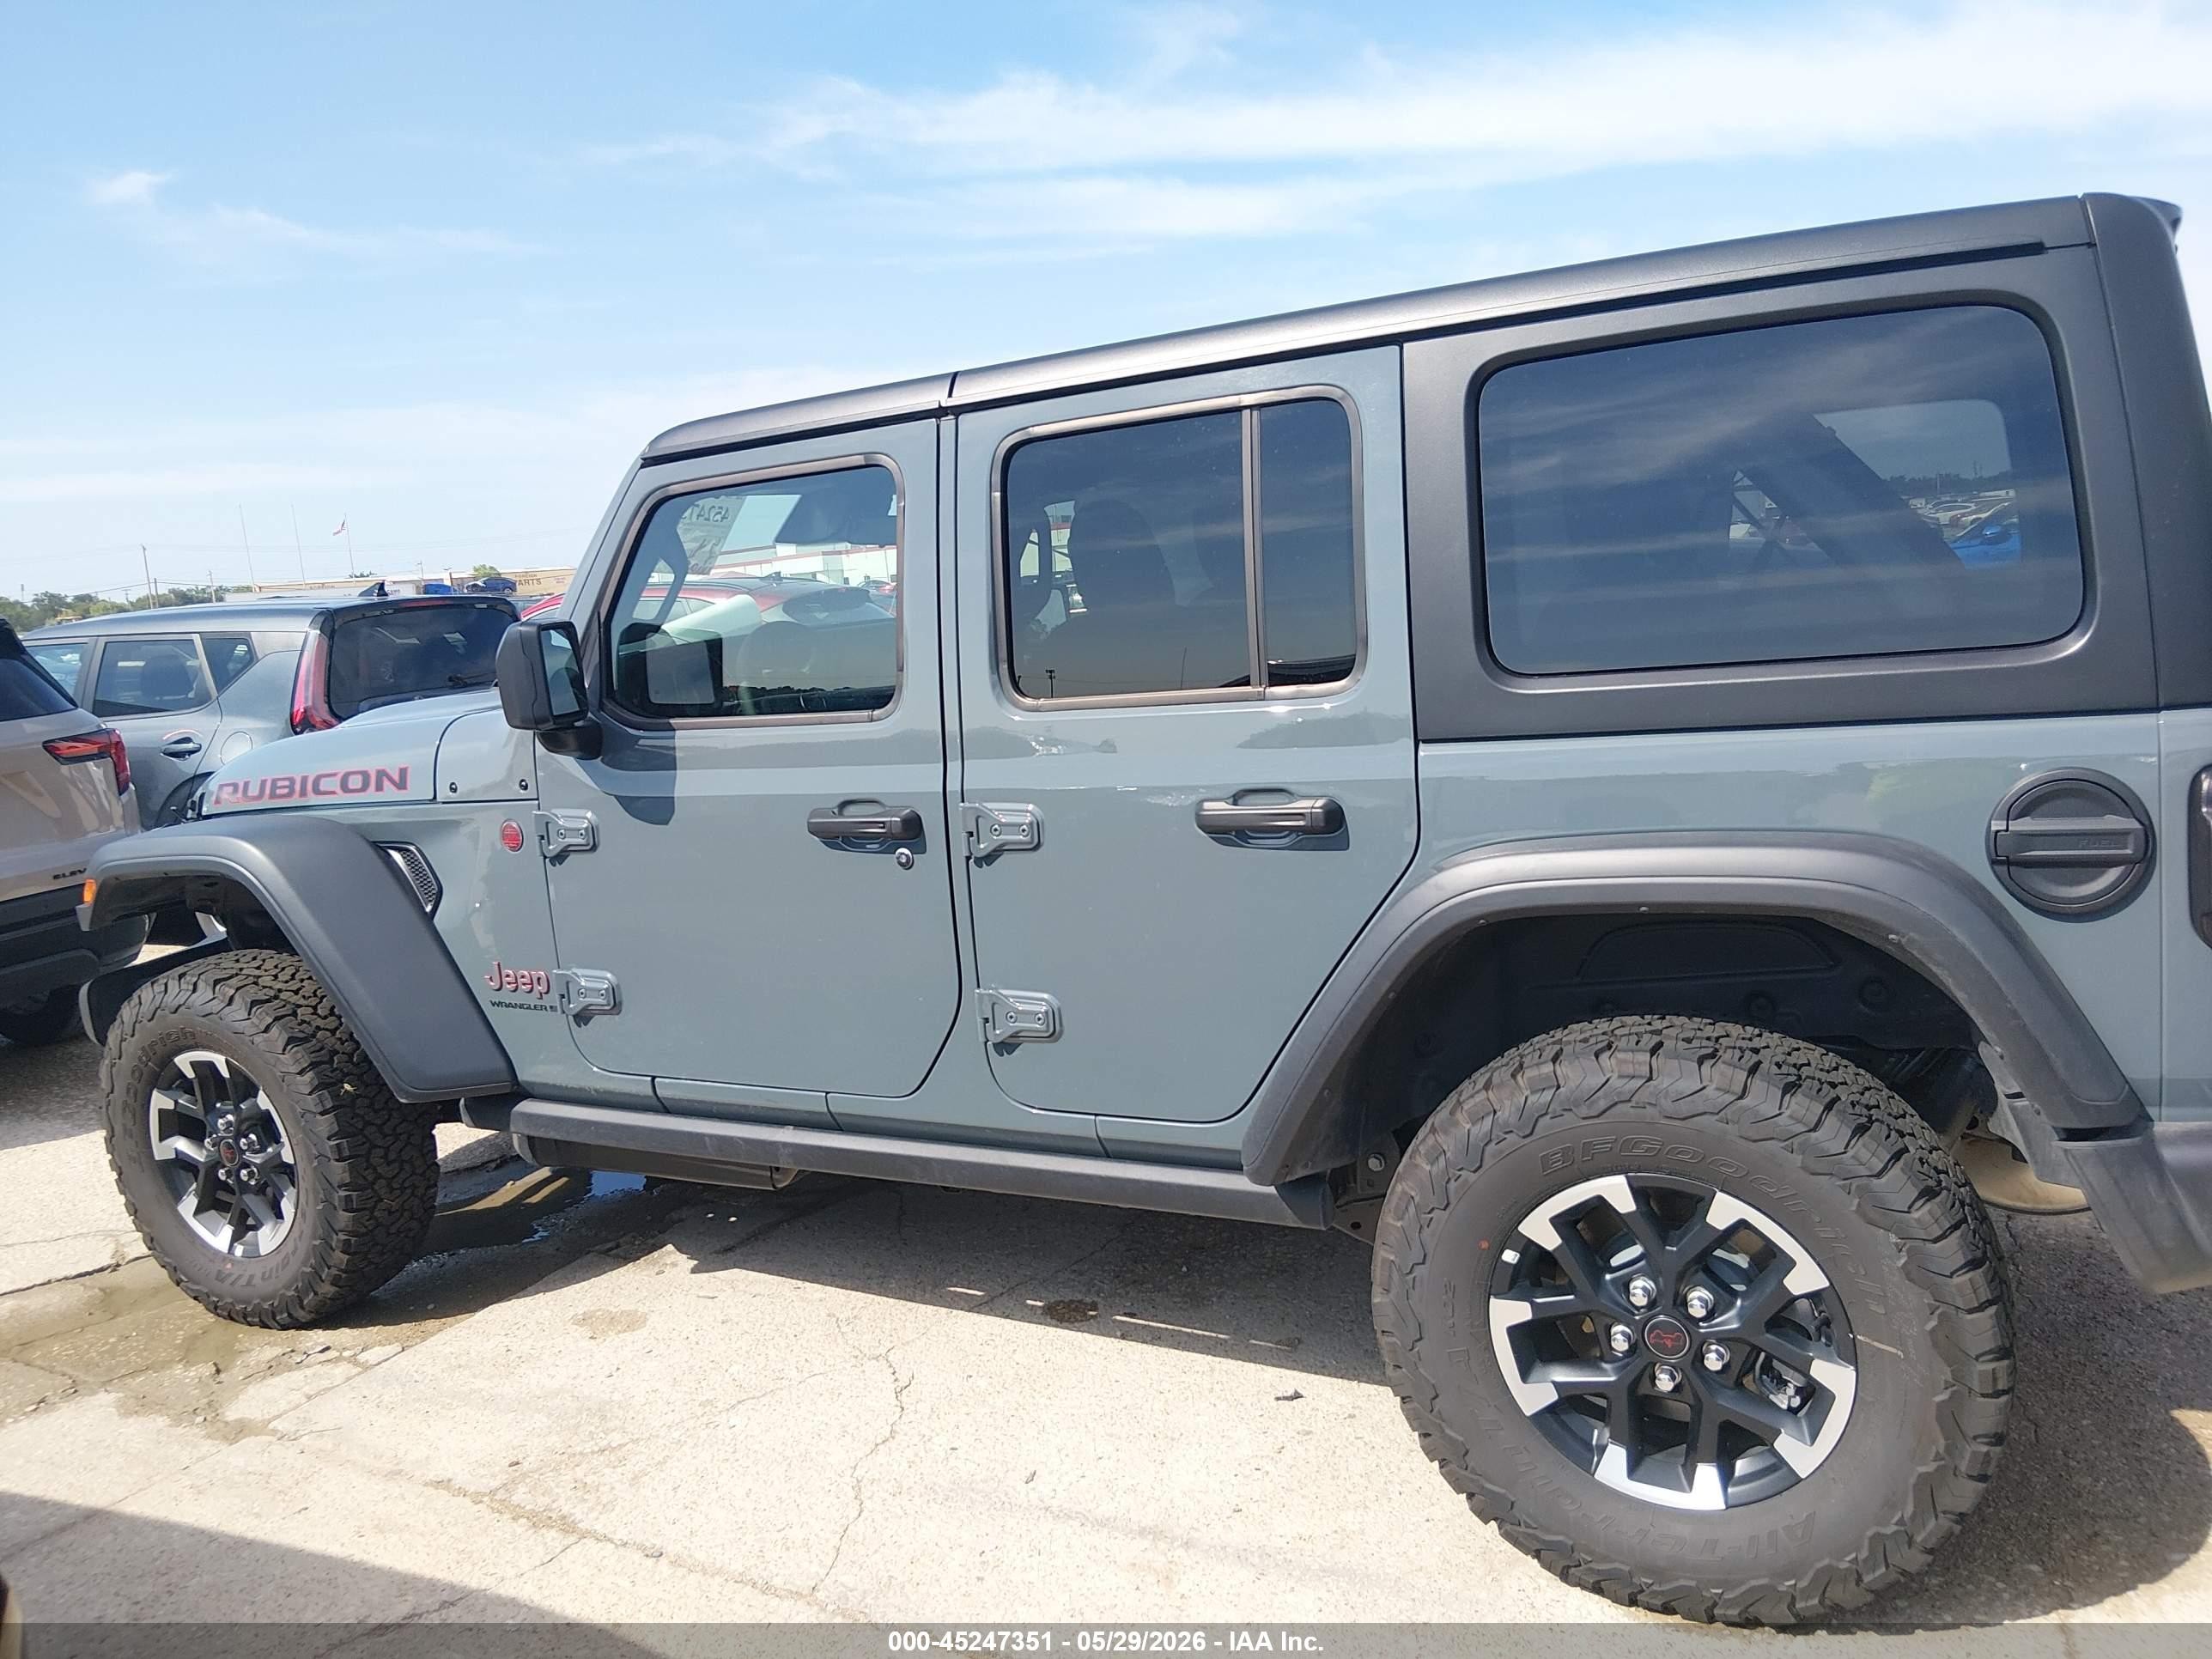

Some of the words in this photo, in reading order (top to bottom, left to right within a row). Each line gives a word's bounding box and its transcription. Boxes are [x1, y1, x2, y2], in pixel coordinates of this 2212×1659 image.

[517, 578, 542, 586] ARTS
[212, 764, 411, 805] RUBICON
[2079, 840, 2121, 848] FUEL
[483, 961, 550, 1000] Jeep
[489, 1000, 549, 1012] WRANGLER
[1538, 1134, 1888, 1316] BFGoodrich
